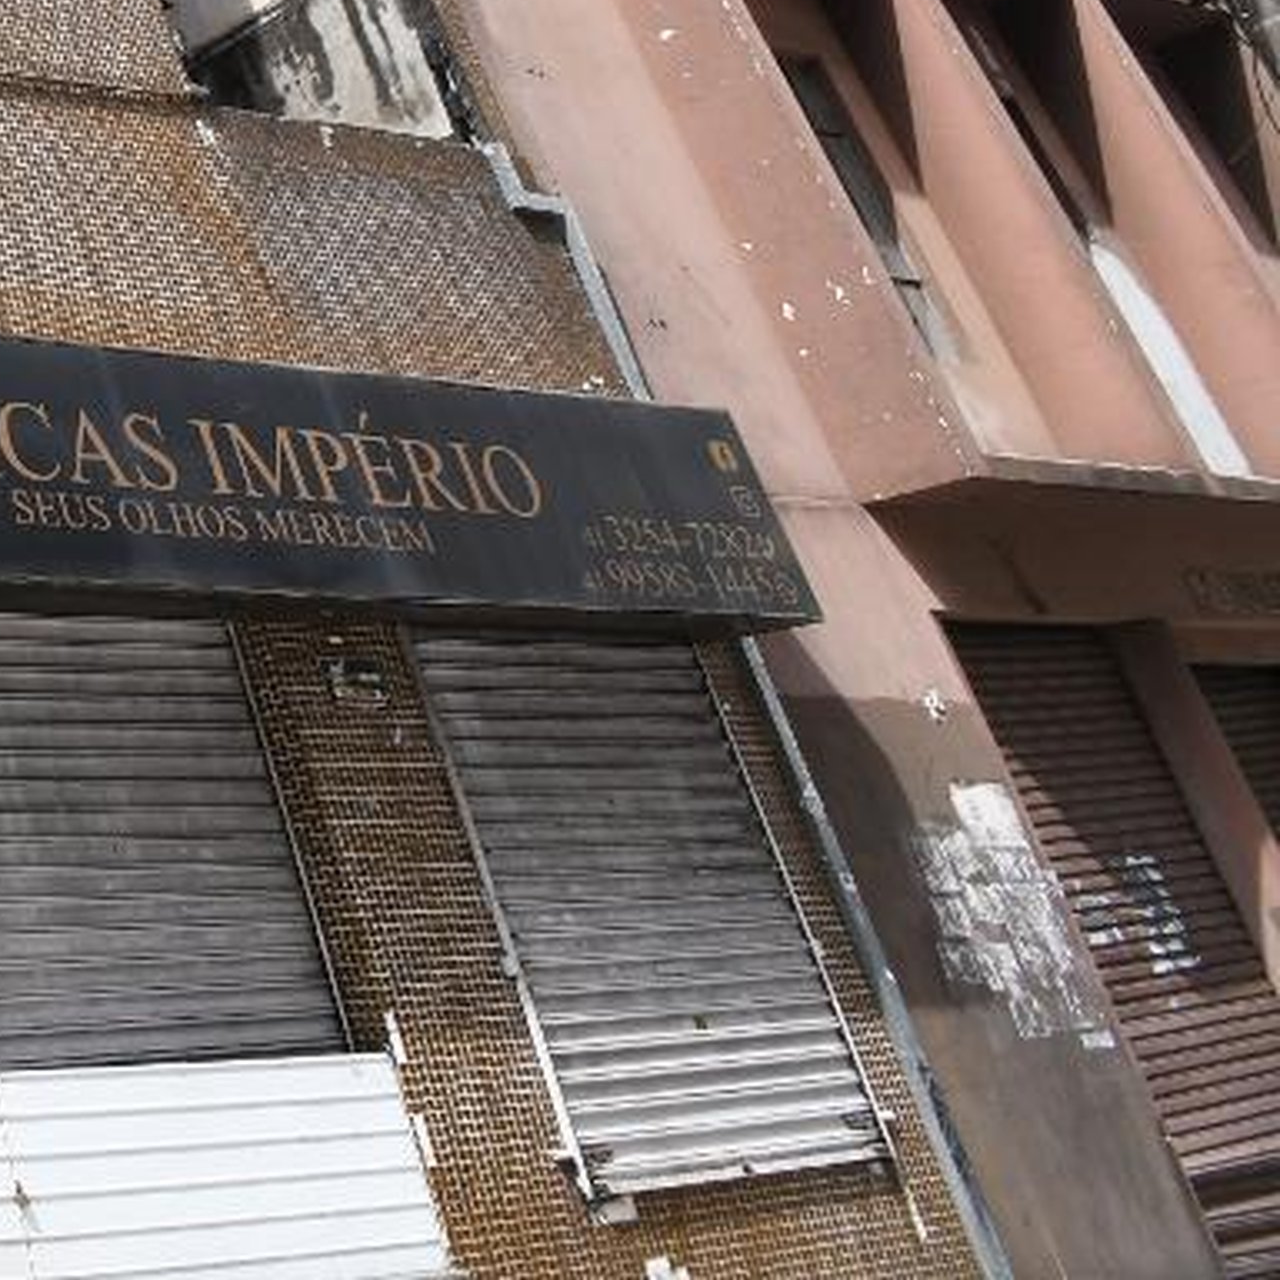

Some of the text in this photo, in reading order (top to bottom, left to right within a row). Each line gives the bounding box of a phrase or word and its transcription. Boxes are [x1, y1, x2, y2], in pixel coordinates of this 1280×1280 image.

[187, 412, 541, 518] IMPÉRIO
[11, 488, 434, 554] SEUS OLHOS MERECEM
